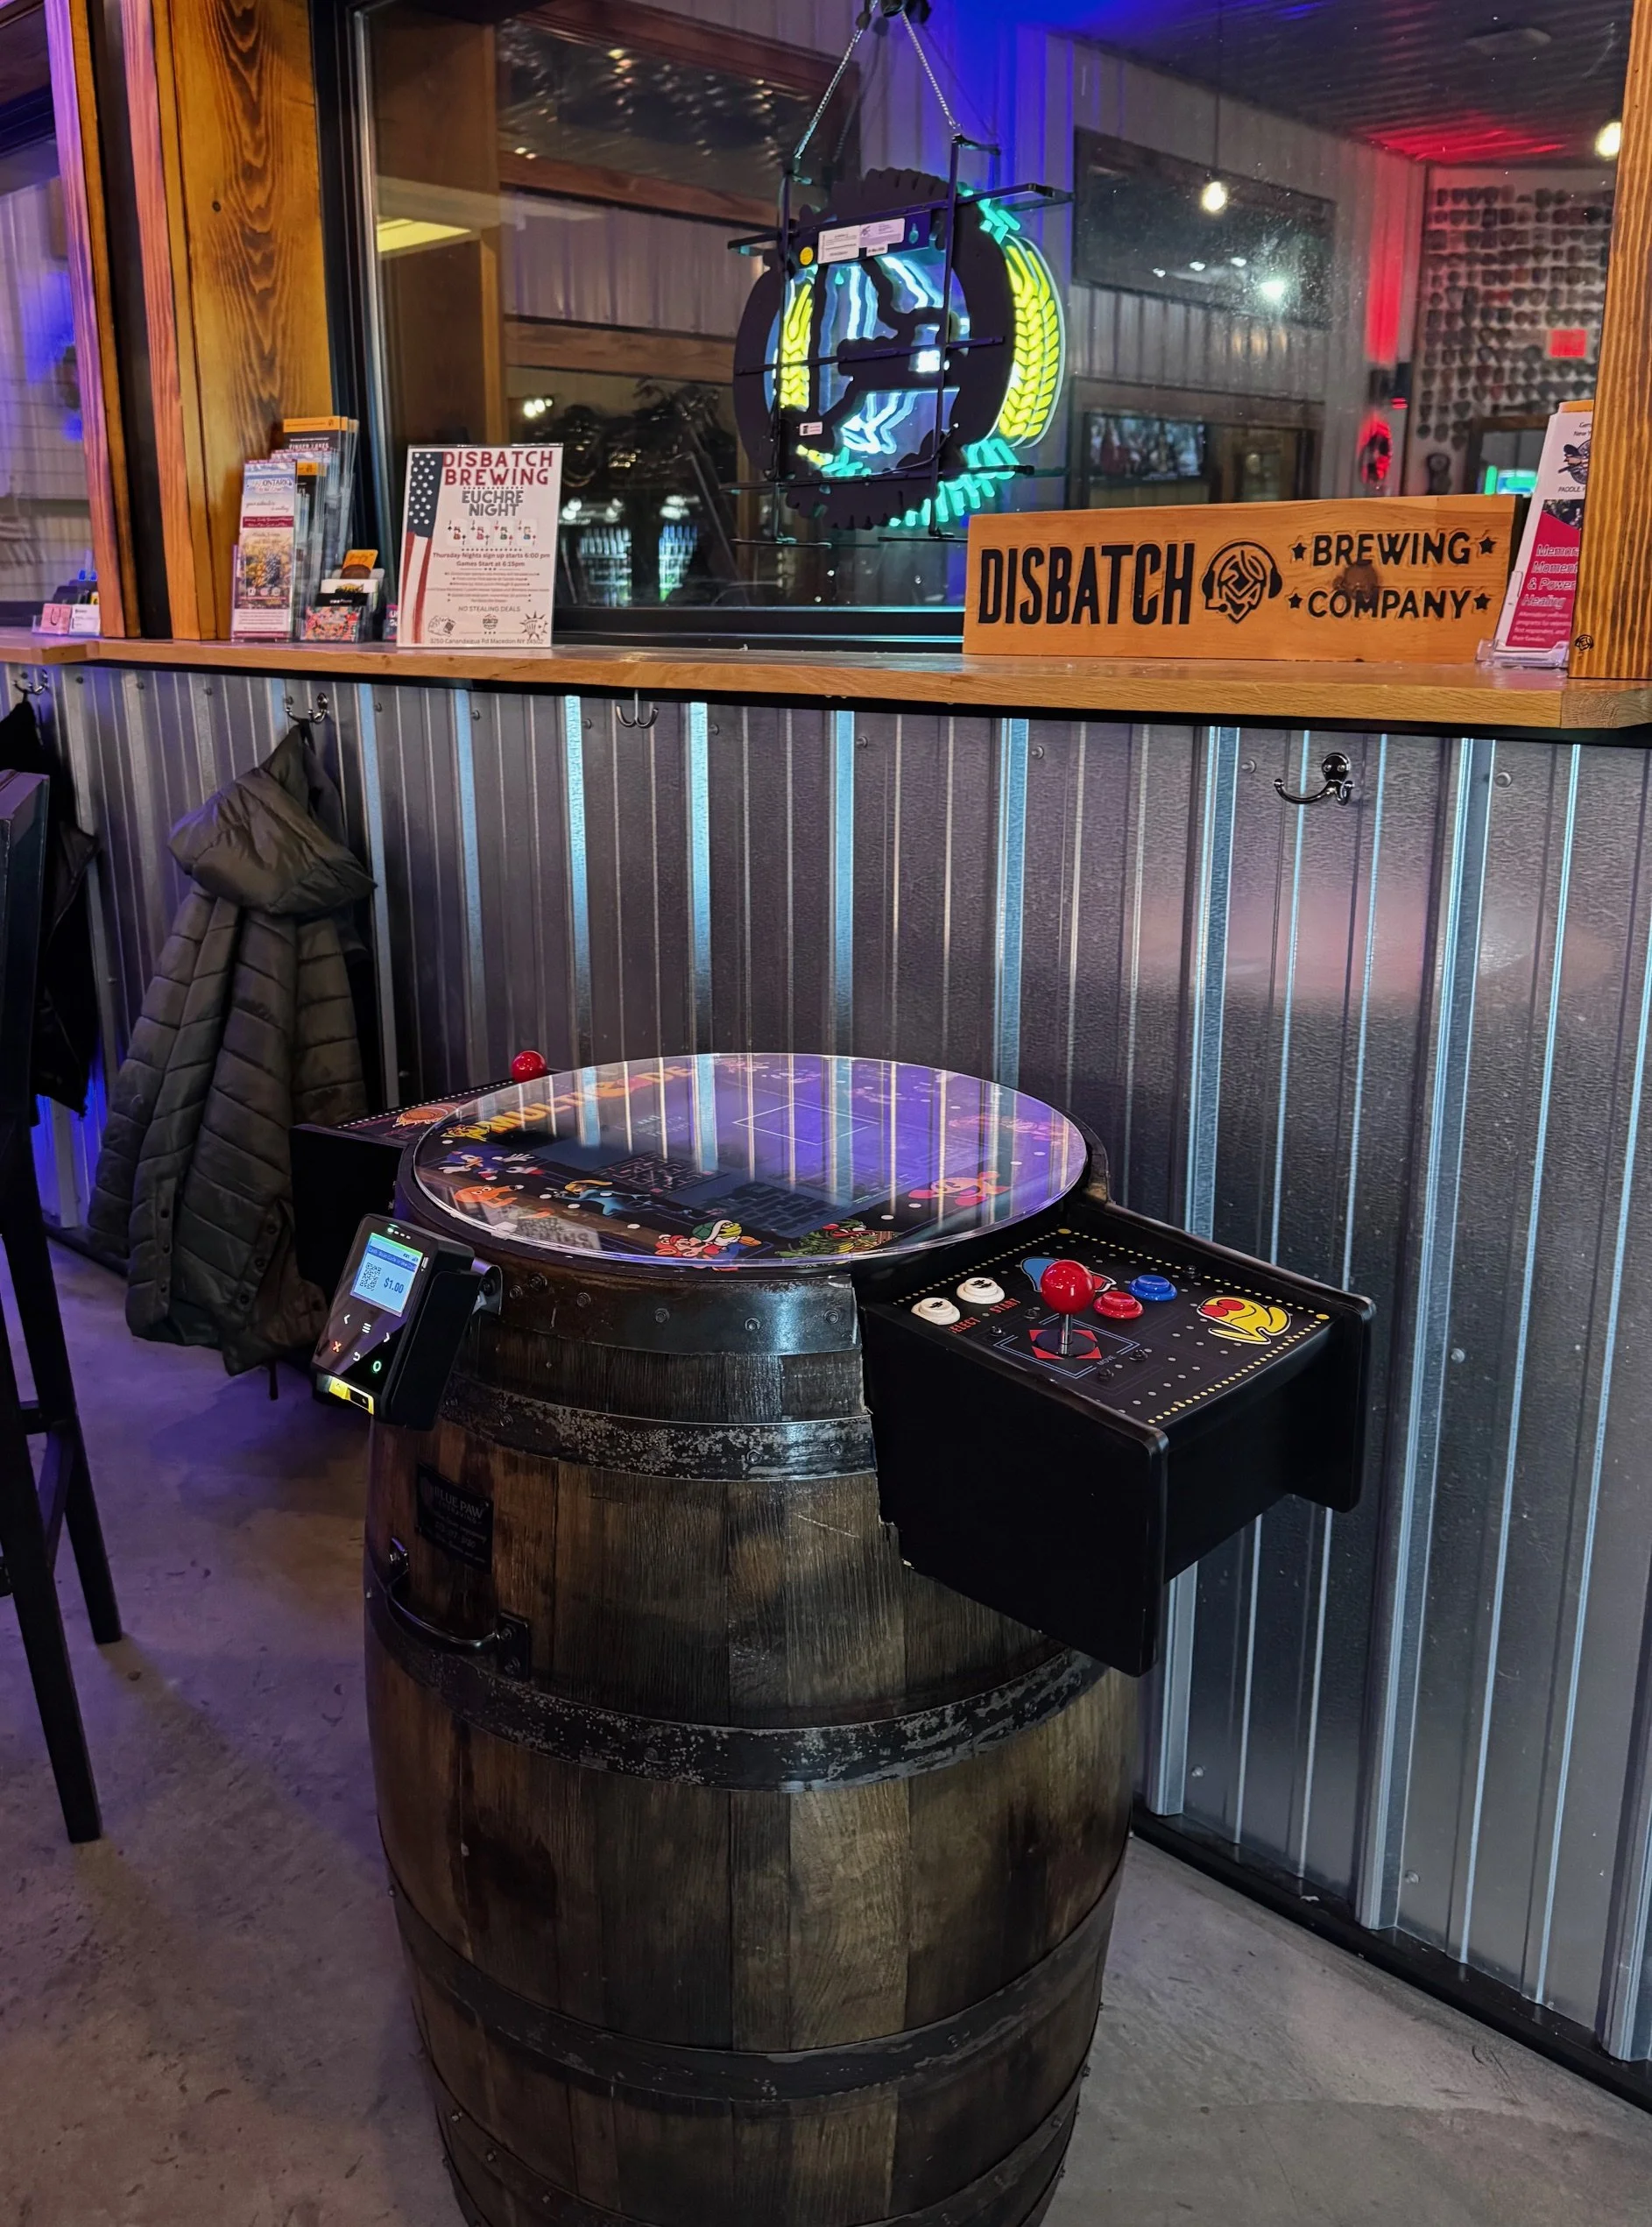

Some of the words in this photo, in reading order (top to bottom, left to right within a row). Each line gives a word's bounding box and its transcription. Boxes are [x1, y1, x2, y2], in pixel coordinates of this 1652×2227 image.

[442, 451, 554, 468] DISBATCH
[444, 469, 549, 485] BREWING
[462, 490, 524, 504] EUCHRE
[469, 503, 519, 516] NIGHT
[1312, 531, 1472, 568] BREWING
[978, 542, 1196, 626] DISBATCH
[1527, 578, 1537, 590] &
[1308, 589, 1472, 620] COMPANY
[1521, 594, 1566, 610] Healing
[383, 1277, 405, 1294] $1.00
[988, 1297, 1022, 1314] START
[1096, 1354, 1118, 1366] MOVE
[459, 1500, 484, 1519] PAW
